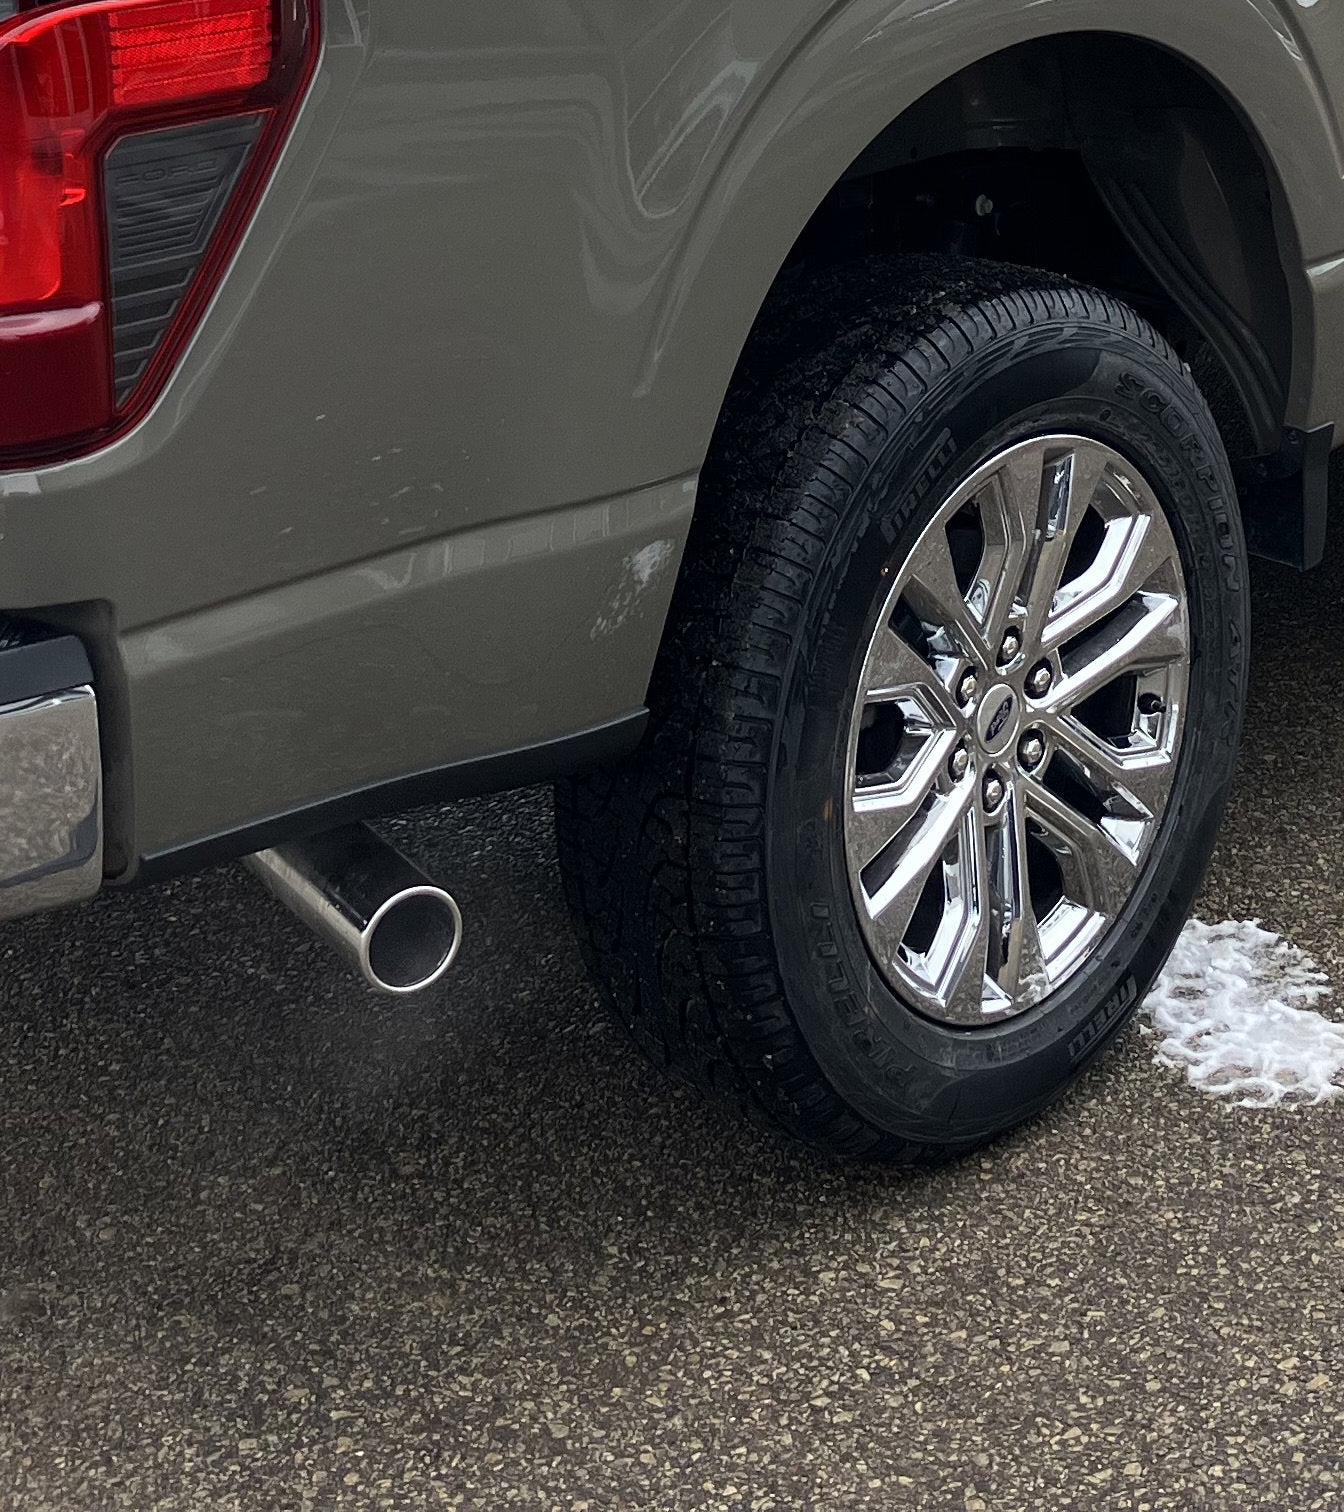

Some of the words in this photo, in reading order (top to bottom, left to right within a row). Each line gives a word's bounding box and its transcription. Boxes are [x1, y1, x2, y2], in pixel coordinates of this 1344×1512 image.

[879, 426, 958, 546] PIRELLI
[1114, 372, 1241, 593] SCORPION
[1067, 973, 1138, 1061] PIRELLI
